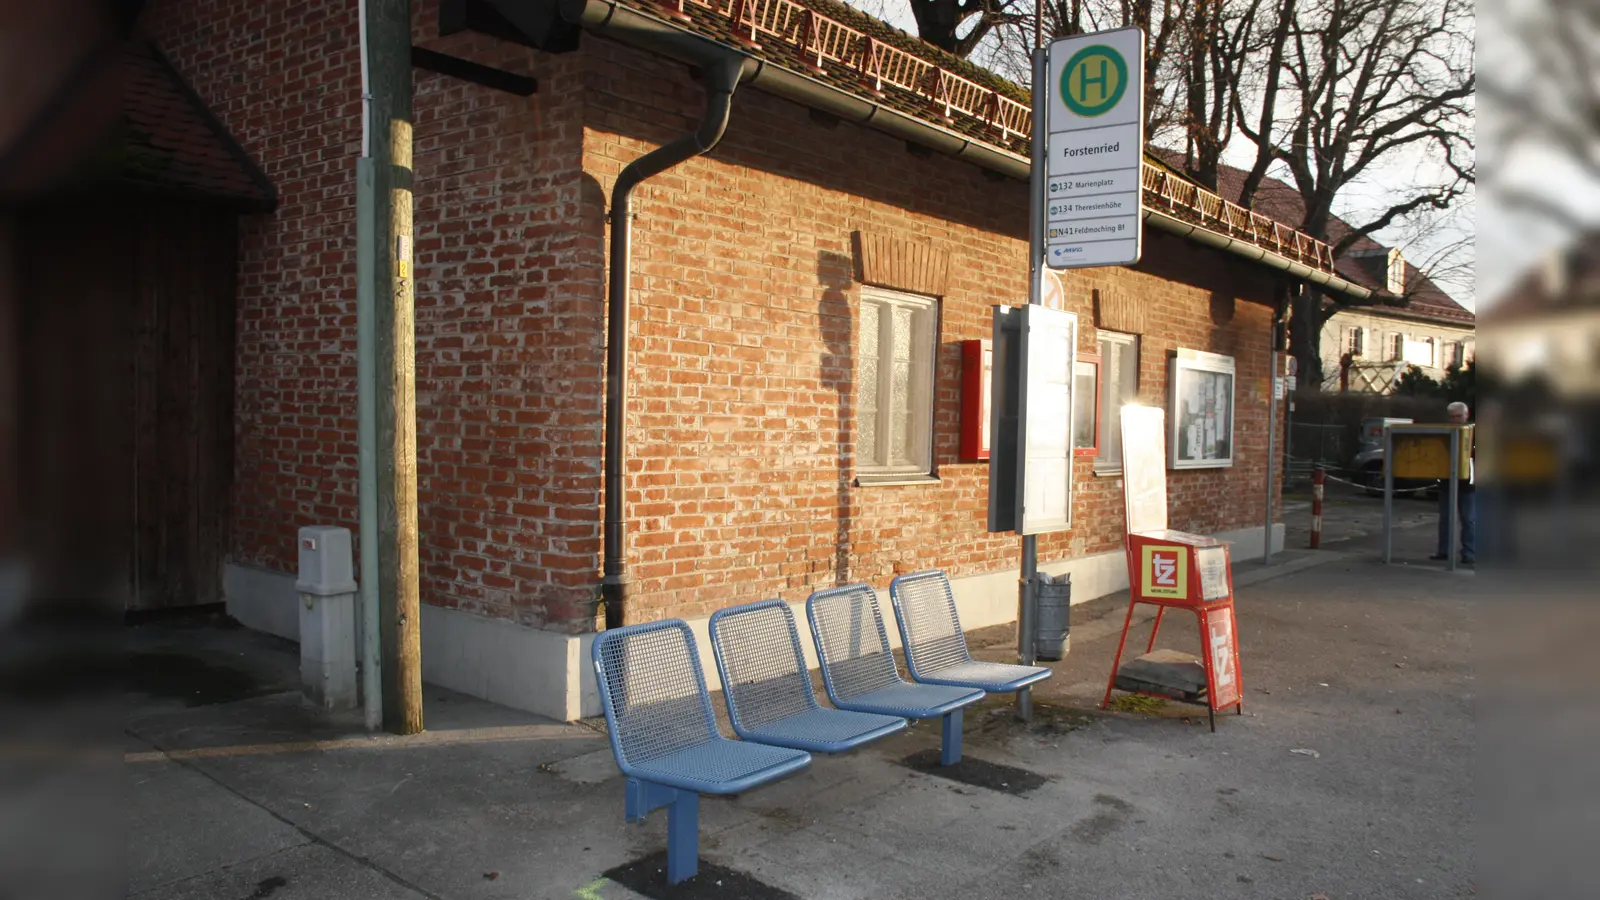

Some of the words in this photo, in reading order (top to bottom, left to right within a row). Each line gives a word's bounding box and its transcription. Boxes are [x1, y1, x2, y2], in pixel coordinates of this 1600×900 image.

[1080, 60, 1107, 102] H
[1064, 142, 1120, 157] Forstenried
[1058, 182, 1073, 190] 132
[1075, 179, 1114, 189] Marienplatz
[1058, 205, 1073, 213] 134
[1075, 202, 1122, 211] Theresienhöhe
[1058, 227, 1074, 235] N41
[1074, 225, 1116, 235] Feldmoching
[1152, 553, 1176, 585] tz
